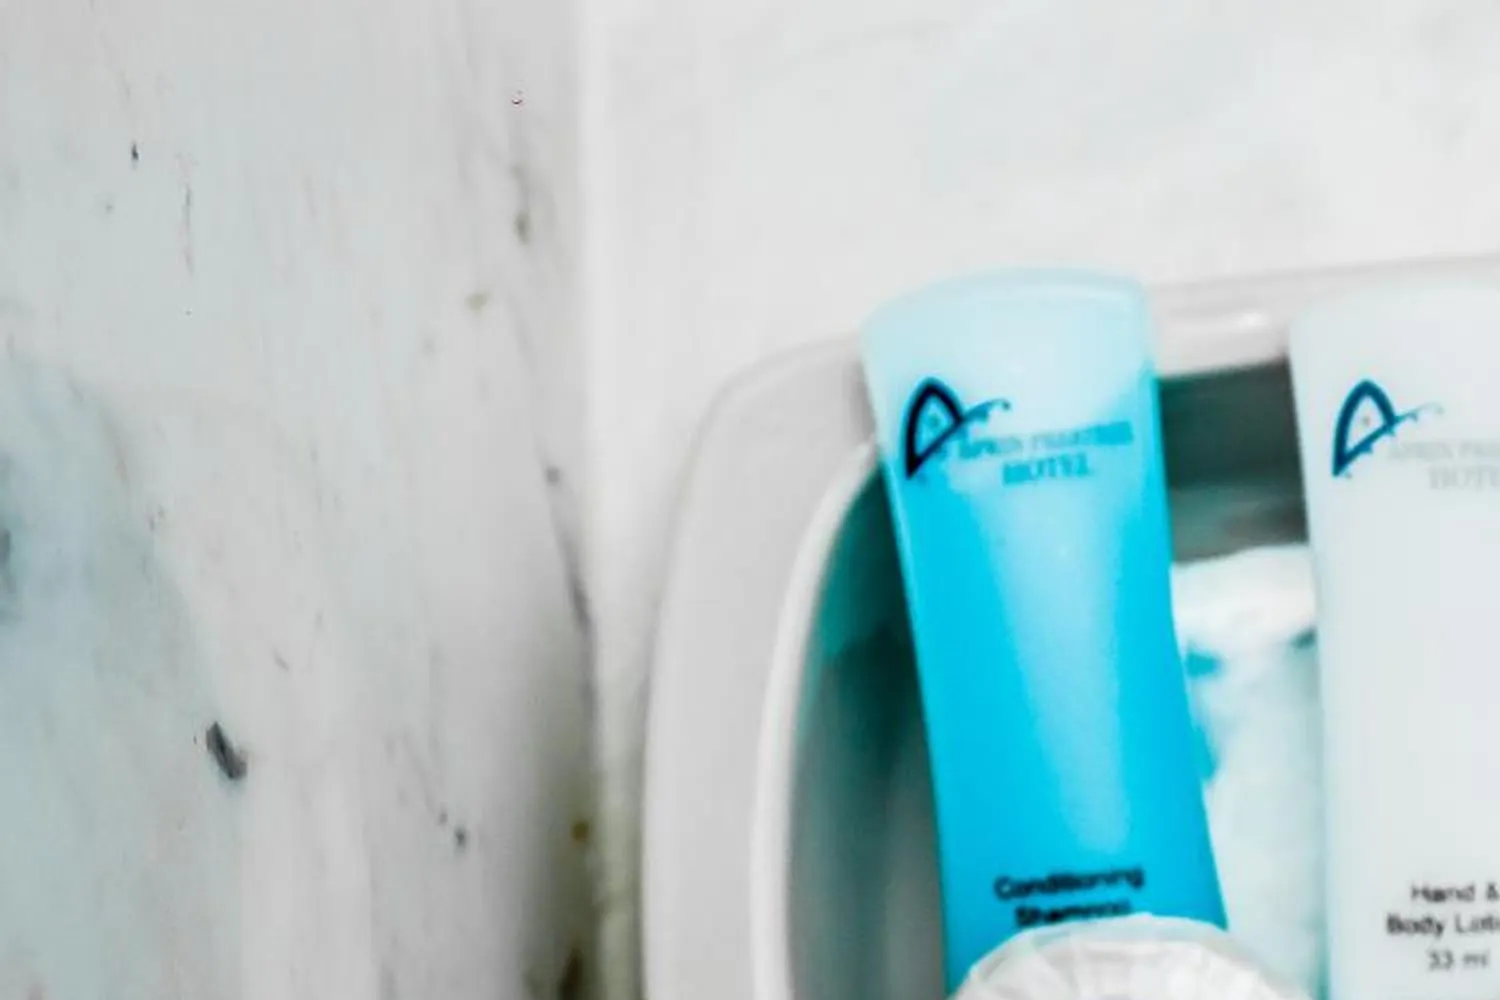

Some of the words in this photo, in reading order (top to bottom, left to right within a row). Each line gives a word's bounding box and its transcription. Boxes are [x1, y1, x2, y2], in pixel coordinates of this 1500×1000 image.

[994, 867, 1144, 900] Conditioning
[1410, 883, 1475, 902] Hand
[1486, 883, 1500, 901] &
[1386, 914, 1444, 939] Body
[1462, 951, 1489, 969] ml
